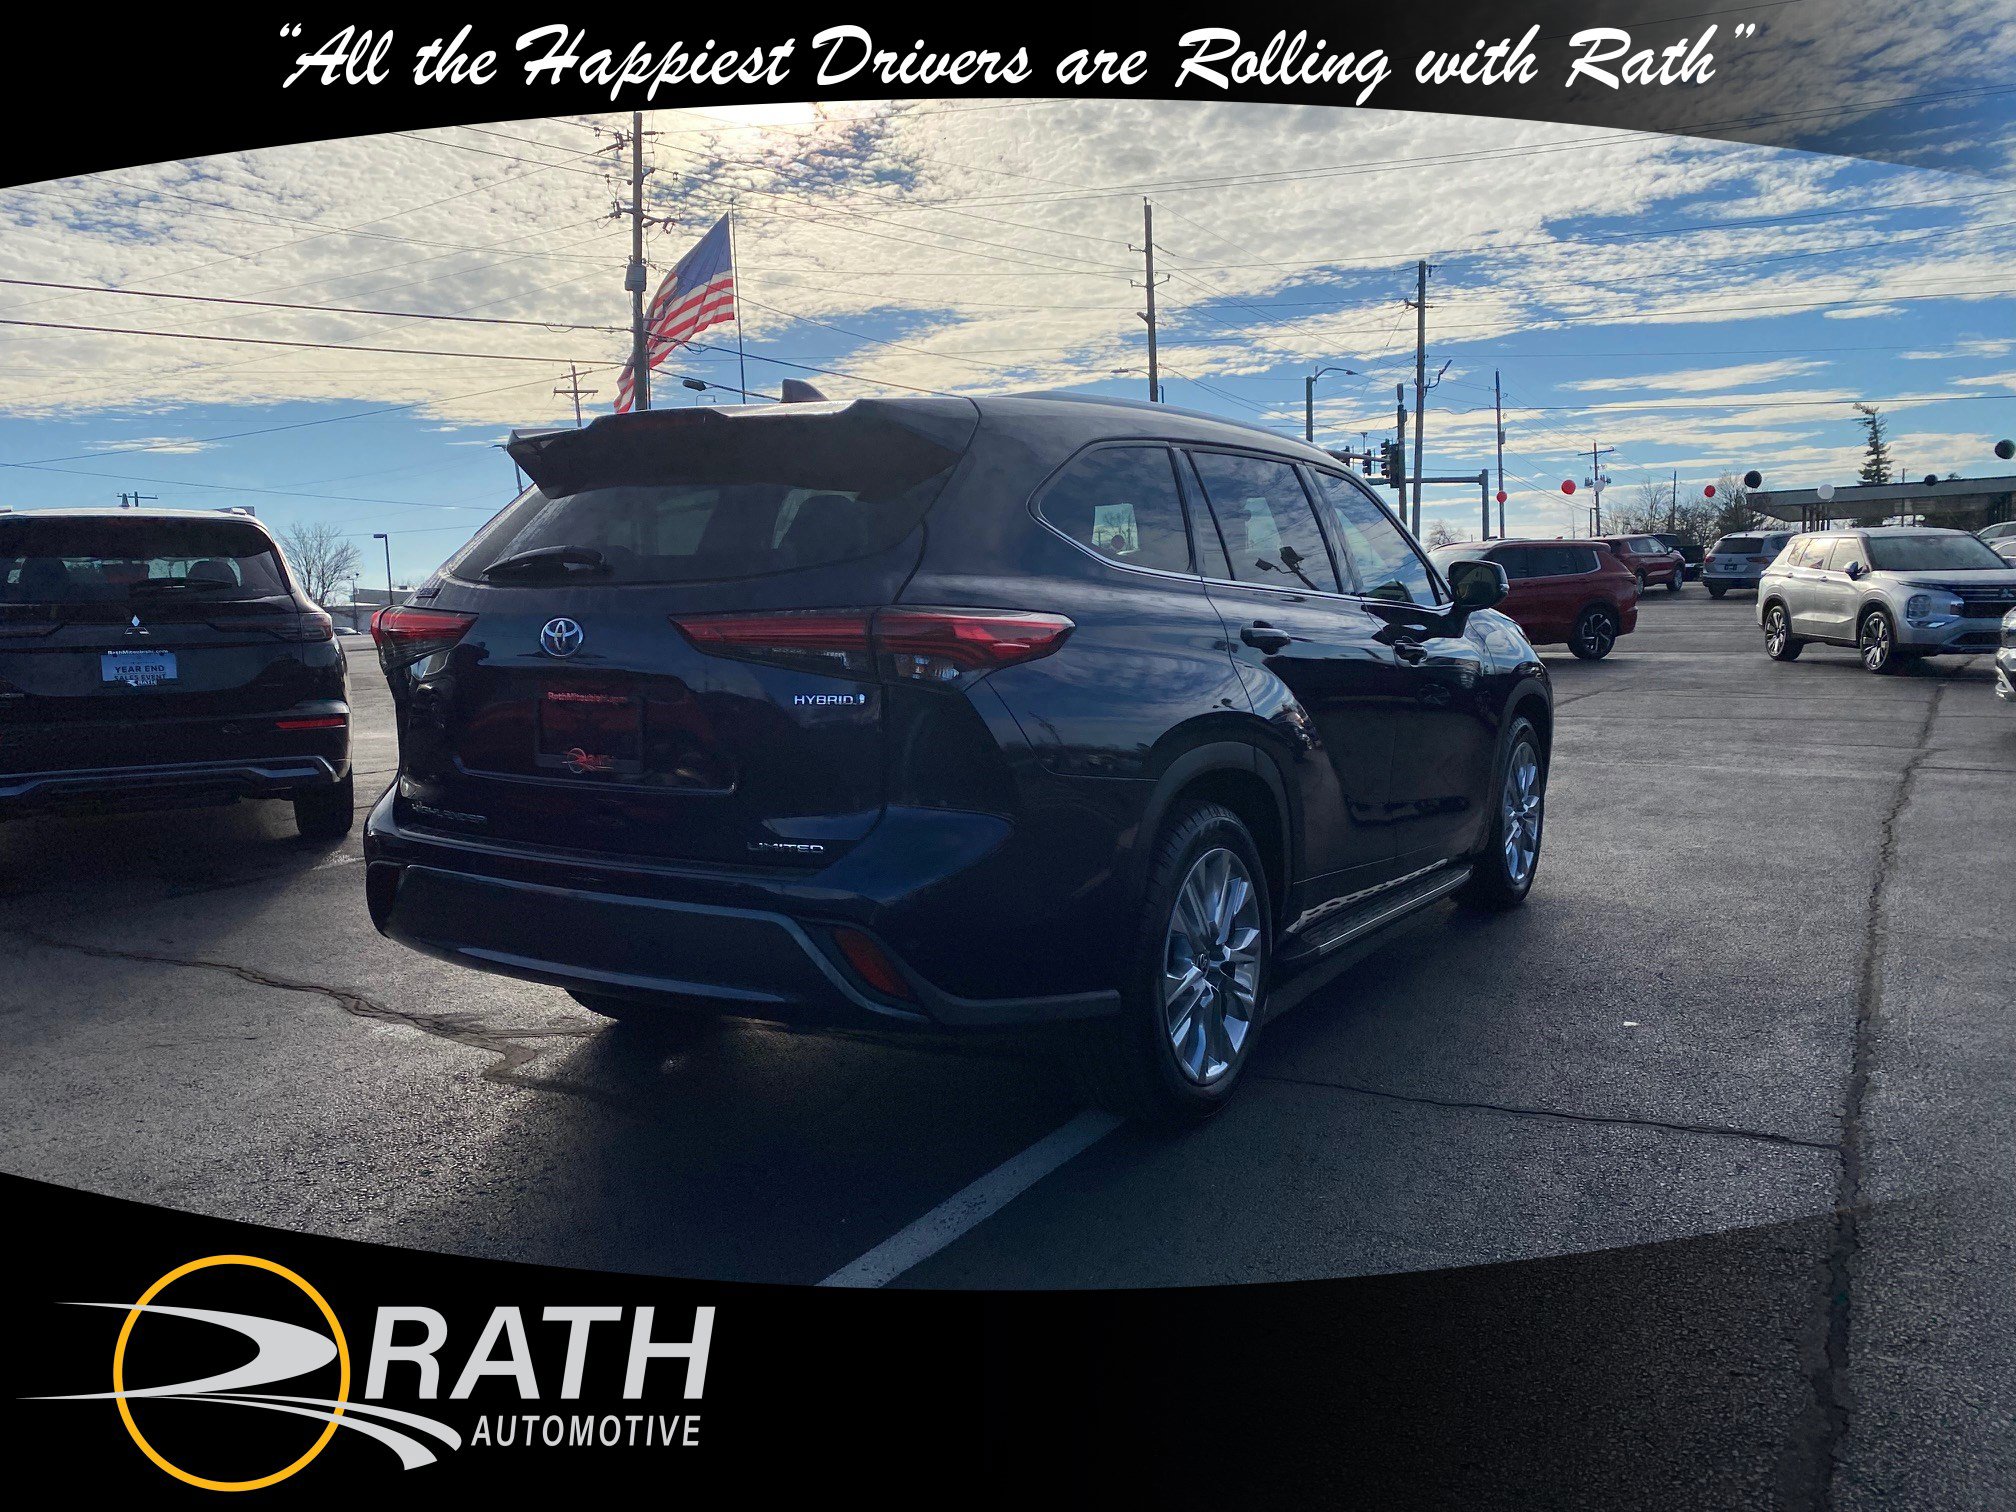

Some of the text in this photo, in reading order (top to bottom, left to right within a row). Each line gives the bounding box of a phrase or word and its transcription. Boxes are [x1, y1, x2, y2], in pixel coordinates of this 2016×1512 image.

[115, 665, 165, 673] YEAR END
[794, 694, 854, 706] HYBRID
[746, 841, 824, 853] LIMITED
